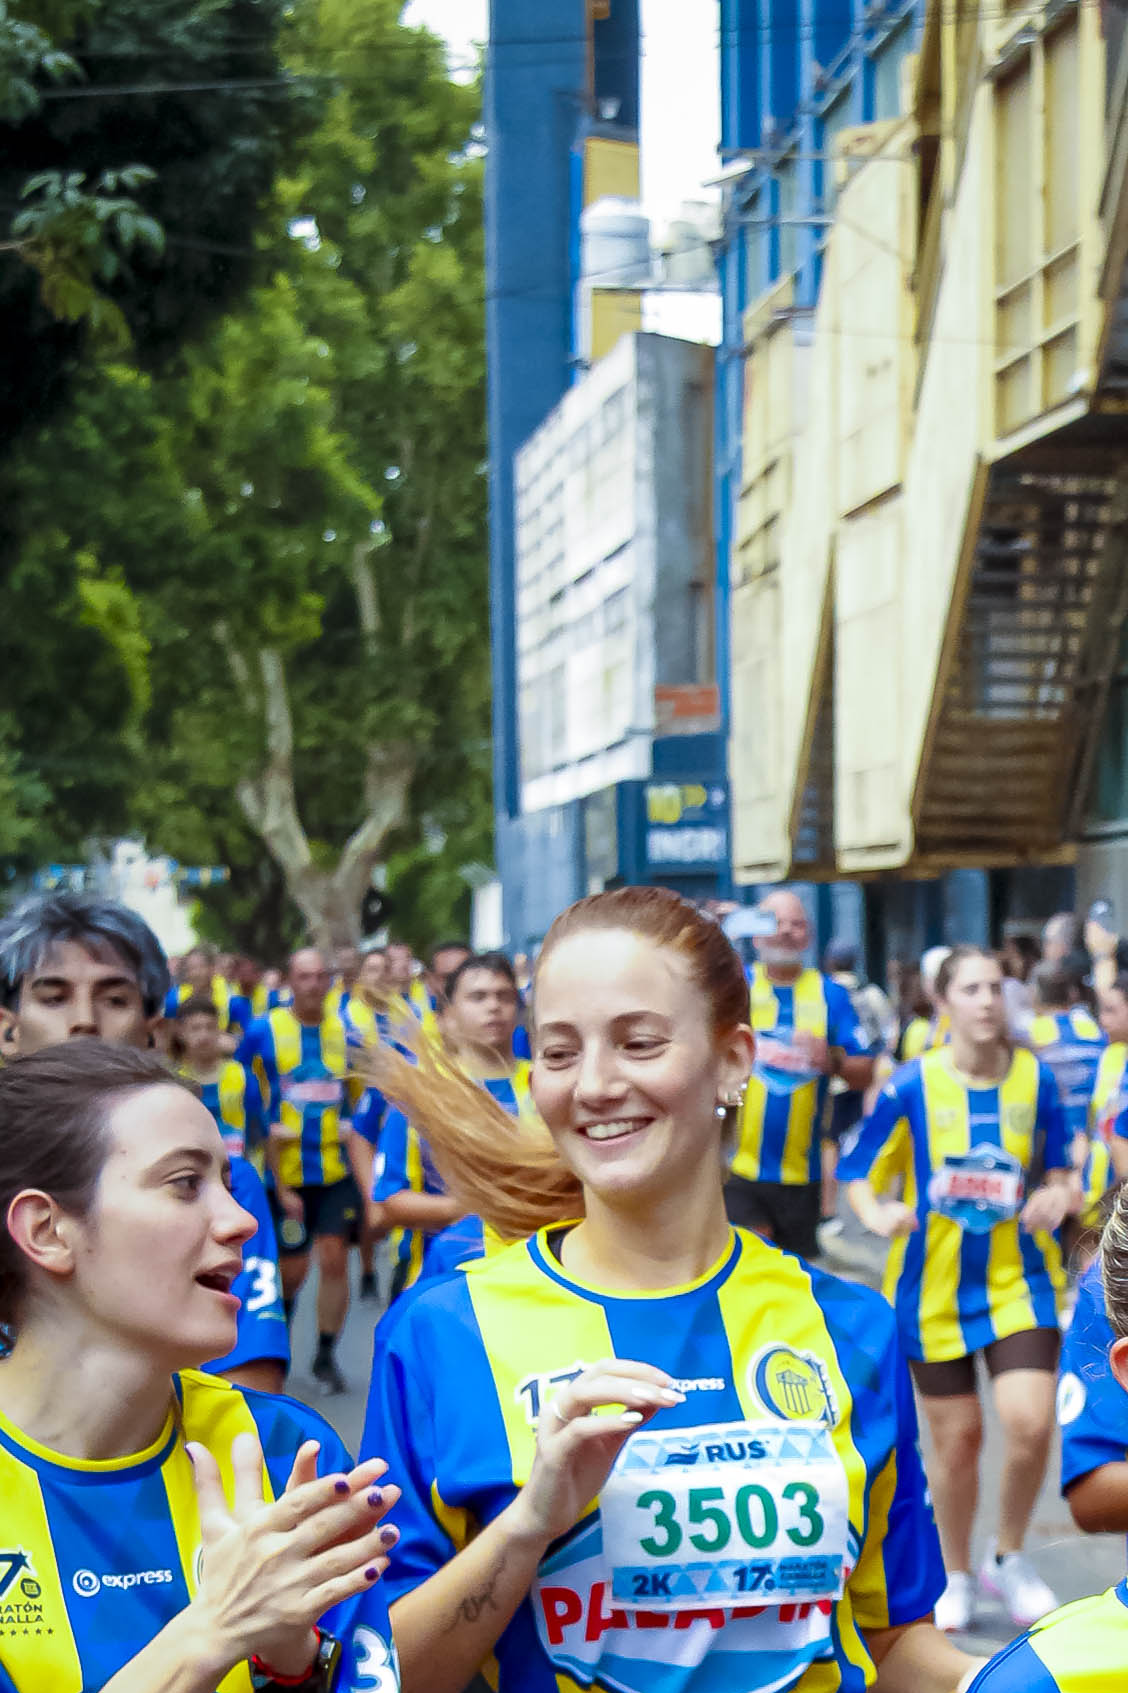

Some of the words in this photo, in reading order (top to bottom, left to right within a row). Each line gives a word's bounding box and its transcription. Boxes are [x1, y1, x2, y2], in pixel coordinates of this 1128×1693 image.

[706, 1440, 768, 1463] RUS
[636, 1482, 825, 1558] 3503
[102, 1569, 173, 1590] express
[632, 1573, 672, 1596] 2K
[0, 1601, 43, 1615] ATÓN
